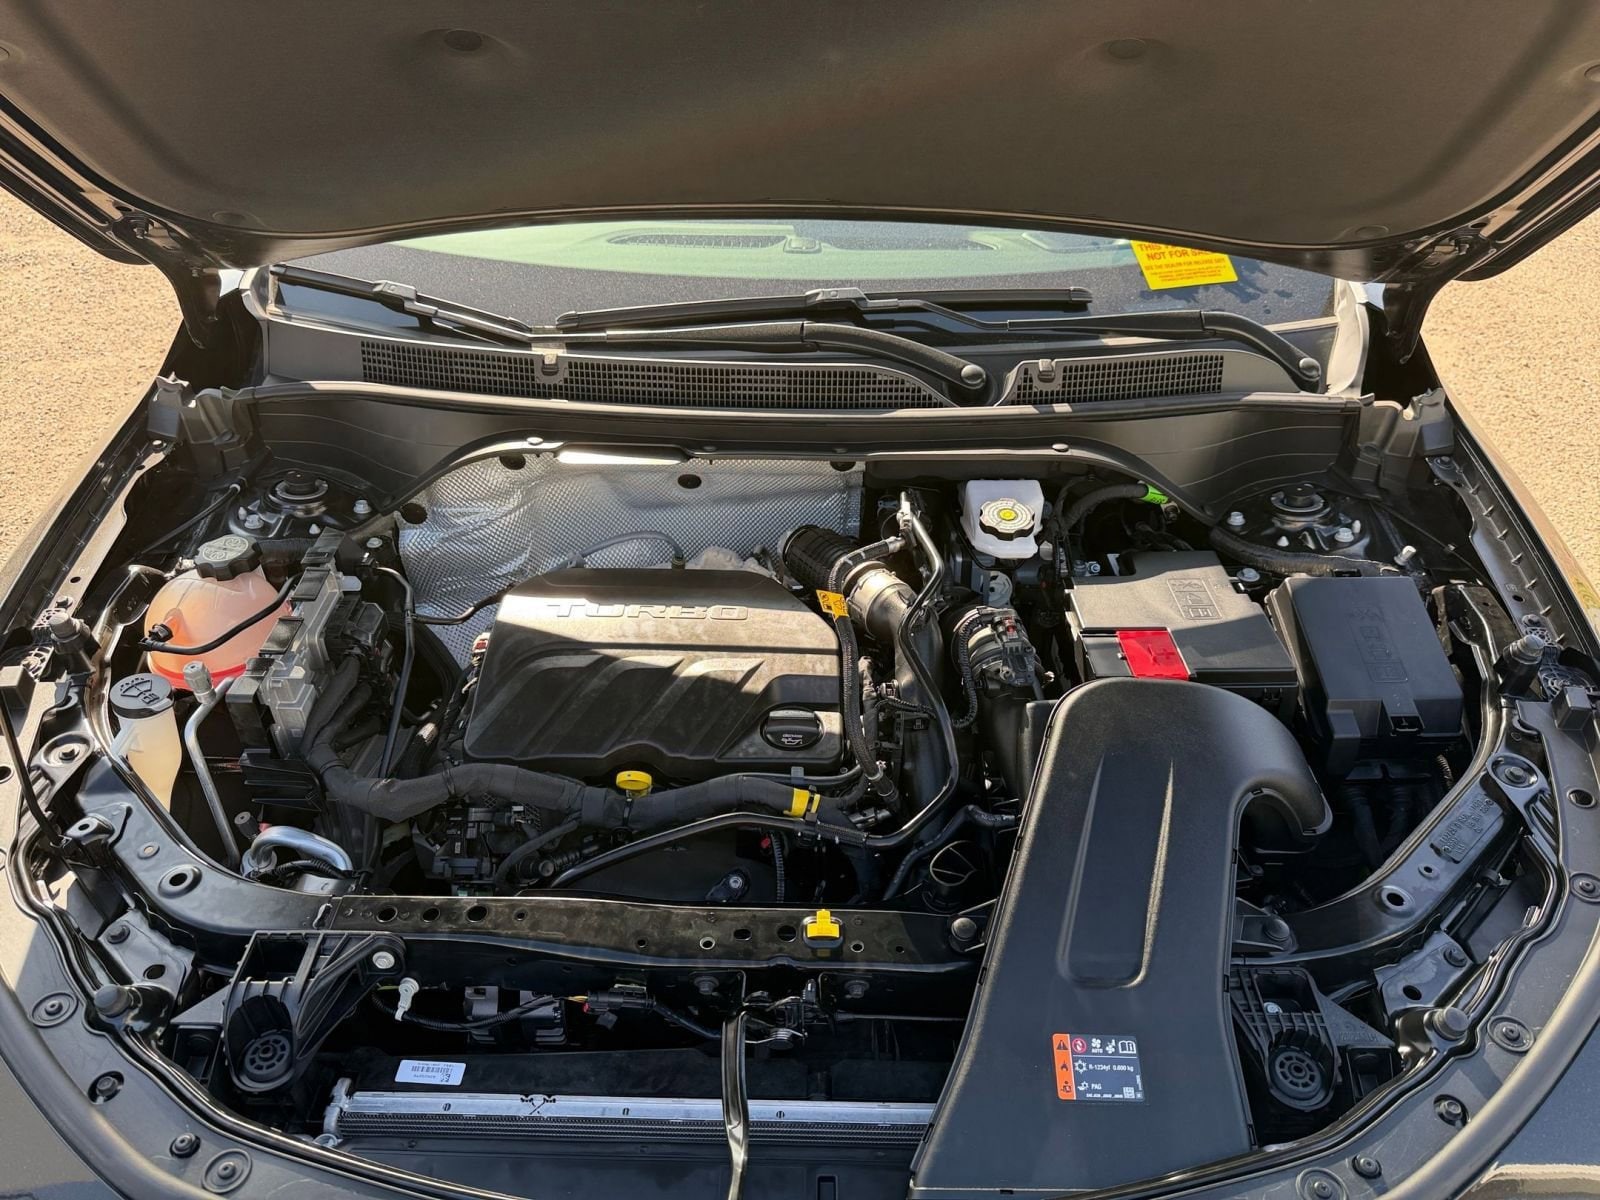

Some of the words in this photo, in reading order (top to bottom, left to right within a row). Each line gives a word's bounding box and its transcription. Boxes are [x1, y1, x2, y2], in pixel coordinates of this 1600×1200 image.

[1146, 251, 1166, 261] NOT
[1168, 249, 1189, 259] FOR
[547, 603, 749, 621] TURBO
